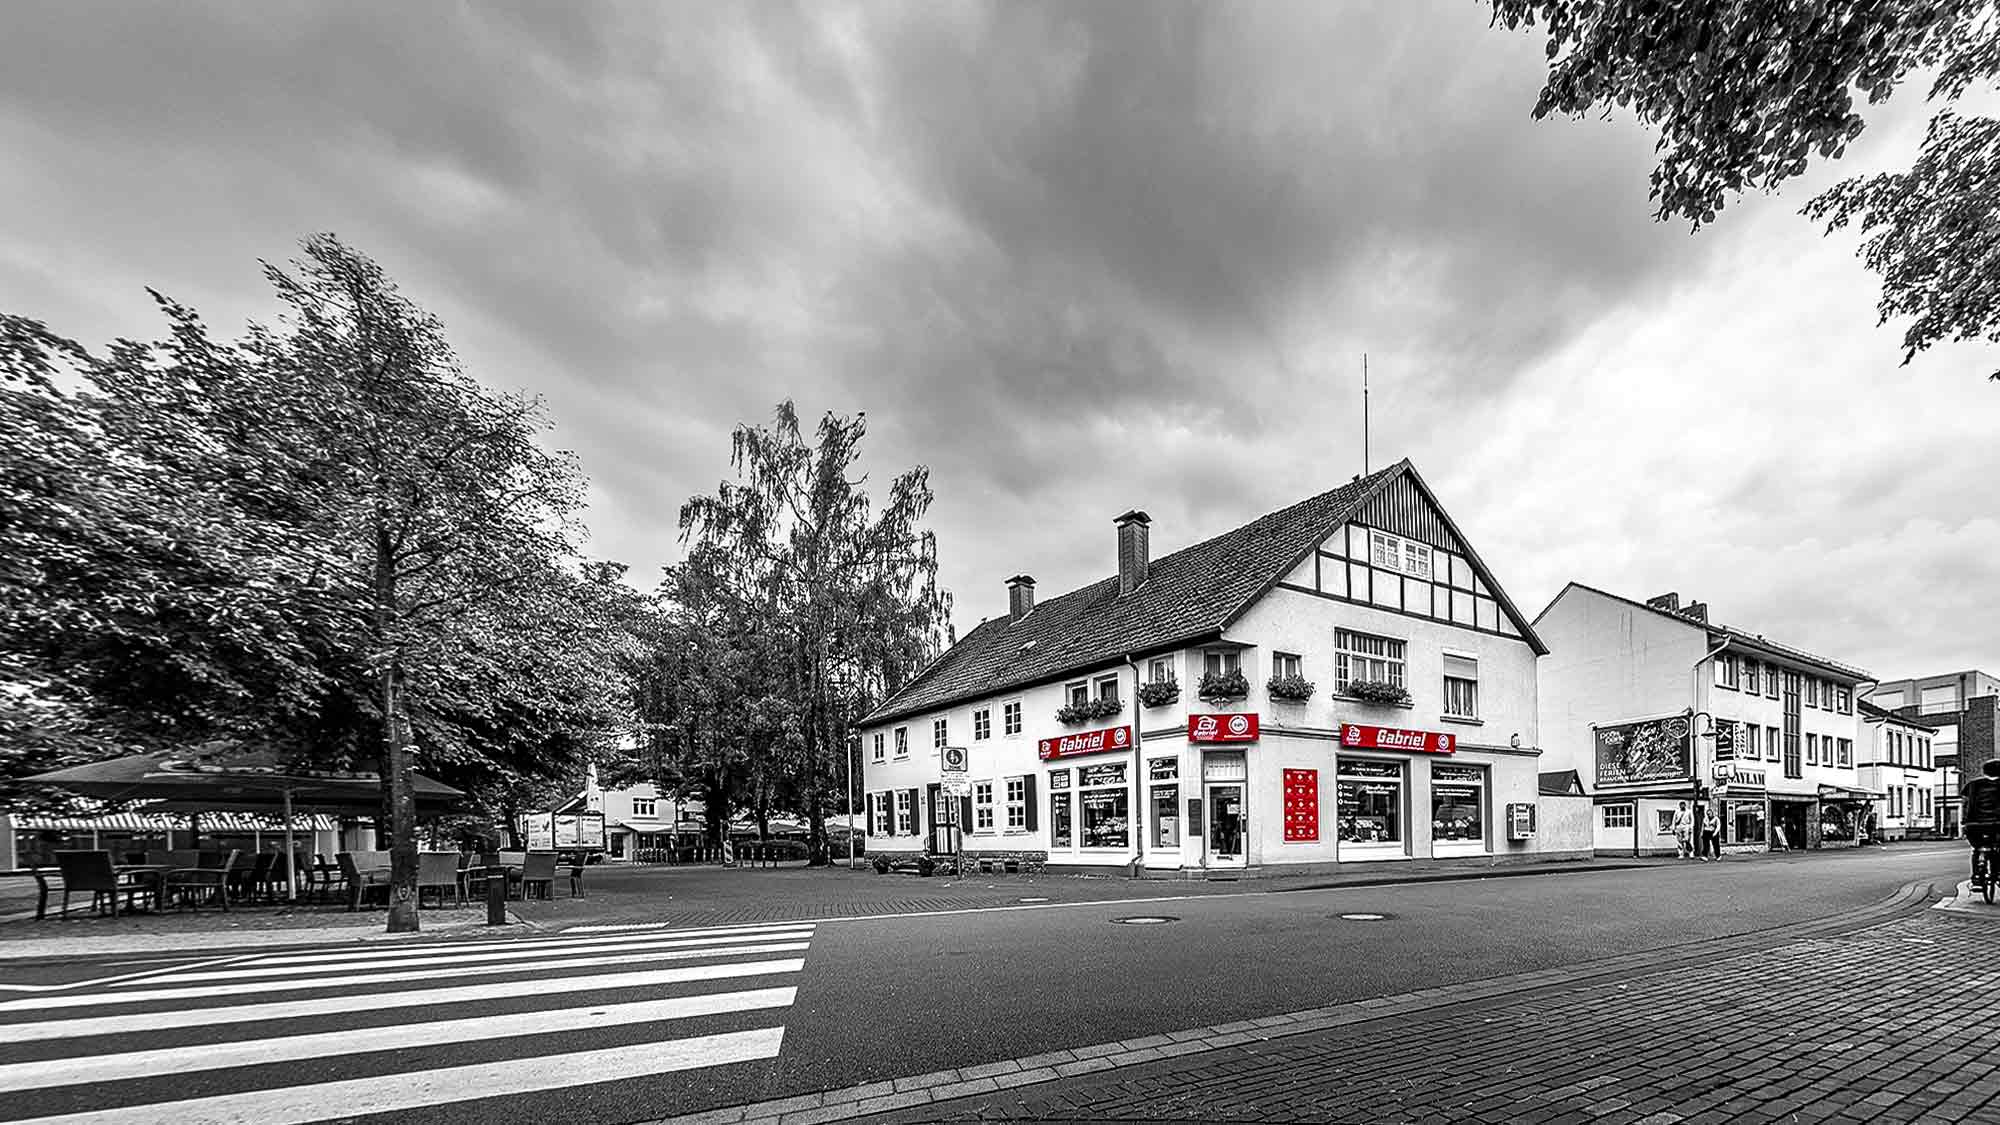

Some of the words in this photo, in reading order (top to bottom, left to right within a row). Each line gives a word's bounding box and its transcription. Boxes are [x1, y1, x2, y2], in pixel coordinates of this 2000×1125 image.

[1059, 731, 1105, 752] Gabriel
[1376, 729, 1427, 747] Gabriel
[1600, 762, 1621, 770] DIESE
